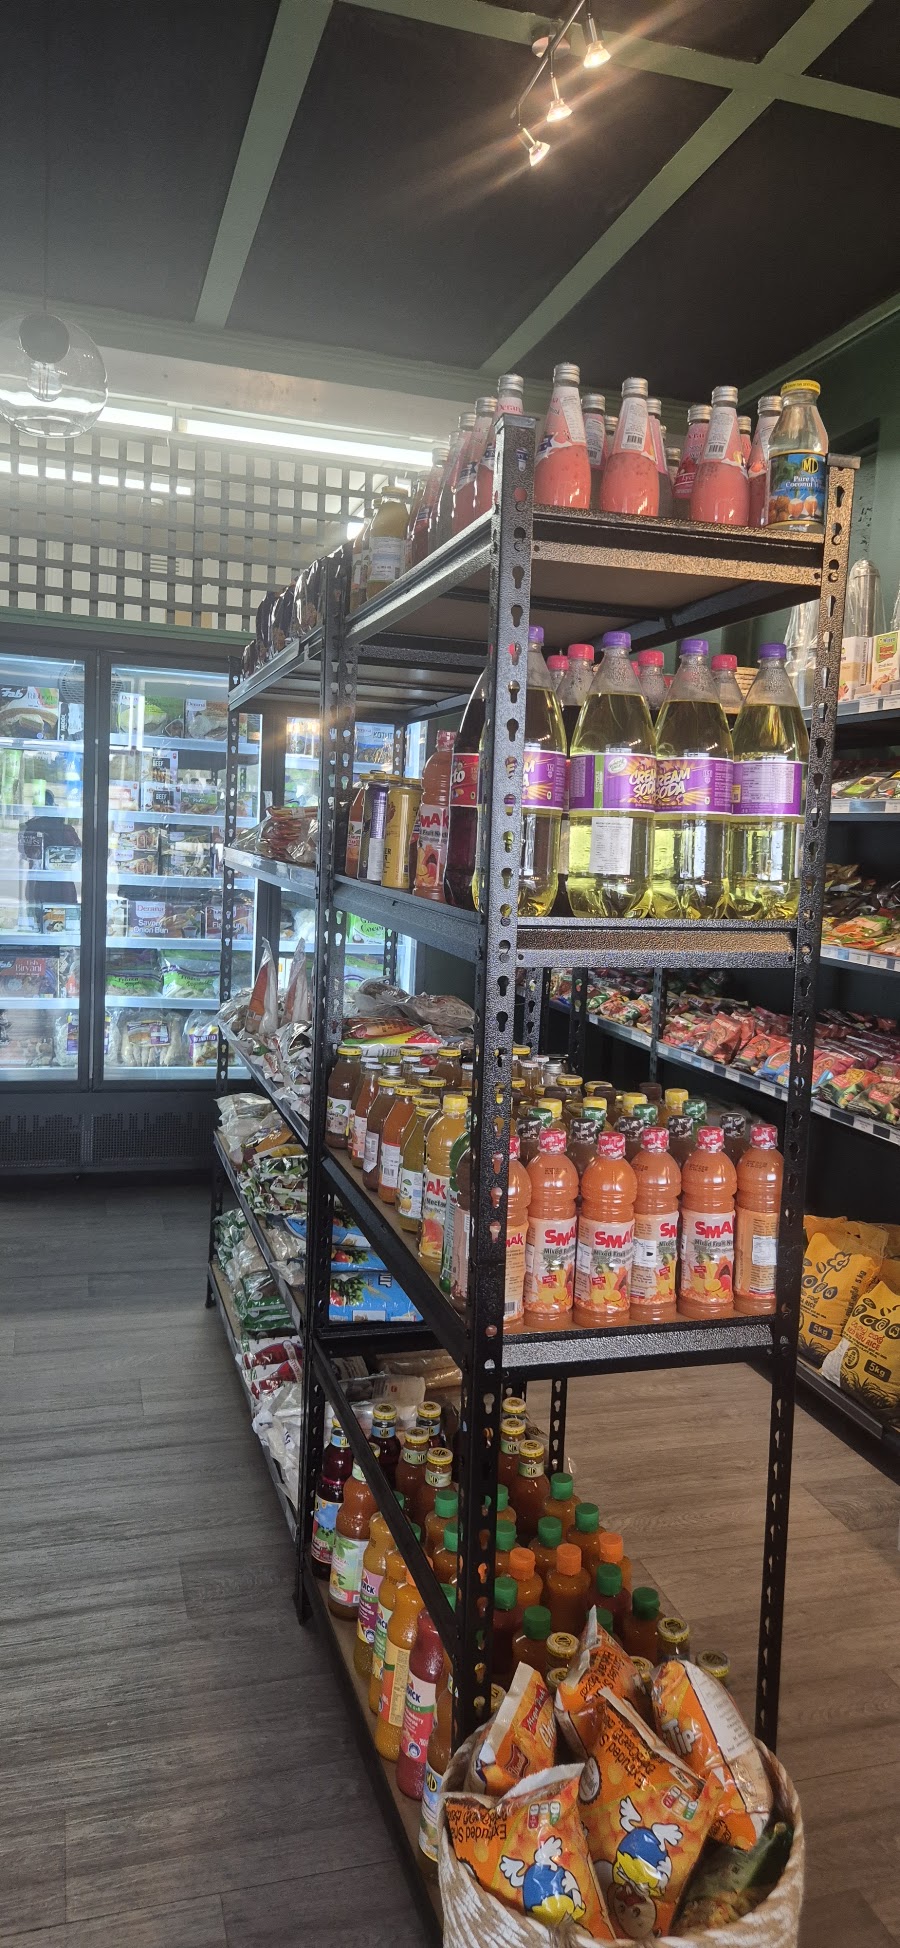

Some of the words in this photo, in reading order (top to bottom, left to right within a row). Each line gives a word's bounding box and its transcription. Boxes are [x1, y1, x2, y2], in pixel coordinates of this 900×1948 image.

[1, 687, 24, 698] Fab
[656, 767, 691, 787] REAM
[420, 808, 449, 828] MAK
[136, 904, 166, 912] Derana
[15, 963, 42, 973] Biryani
[545, 1224, 577, 1247] SMA
[694, 1214, 735, 1239] SMA
[812, 1323, 829, 1337] 5kg
[866, 1338, 881, 1352] RICE
[868, 1361, 886, 1378] 5kg
[606, 1744, 645, 1790] Extruded
[465, 1823, 507, 1843] Extruded
